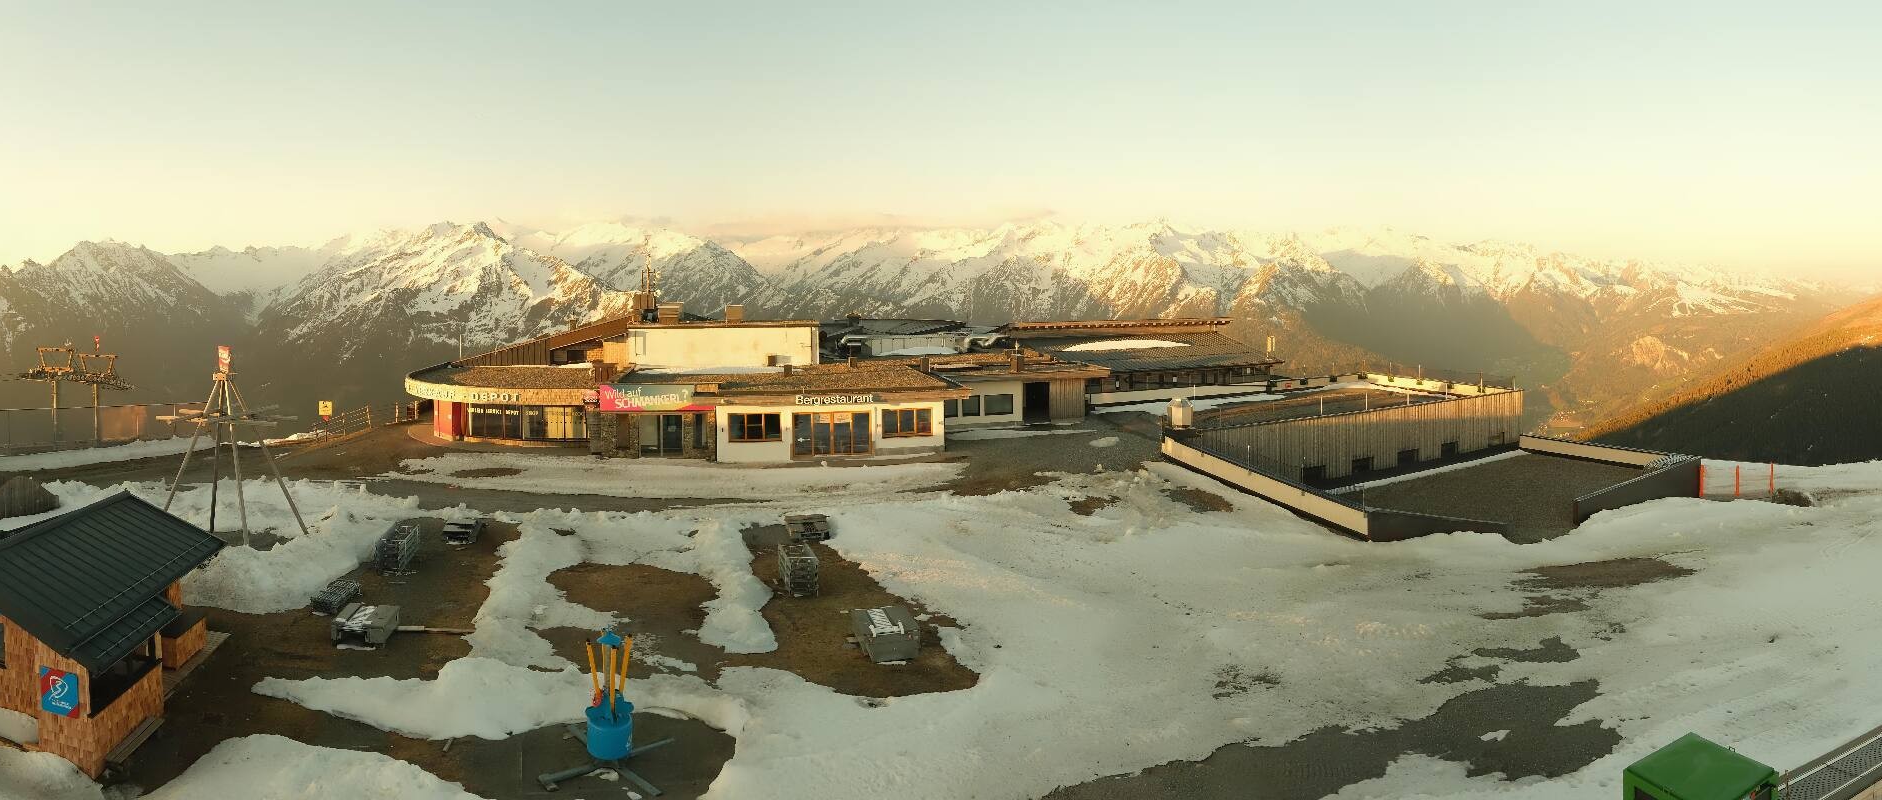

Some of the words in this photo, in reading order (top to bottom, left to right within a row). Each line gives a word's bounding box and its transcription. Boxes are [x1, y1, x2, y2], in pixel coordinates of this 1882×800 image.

[471, 392, 521, 402] DEPOT
[605, 388, 625, 400] Wild
[626, 386, 642, 398] auf
[795, 393, 874, 406] Bergrestaurant
